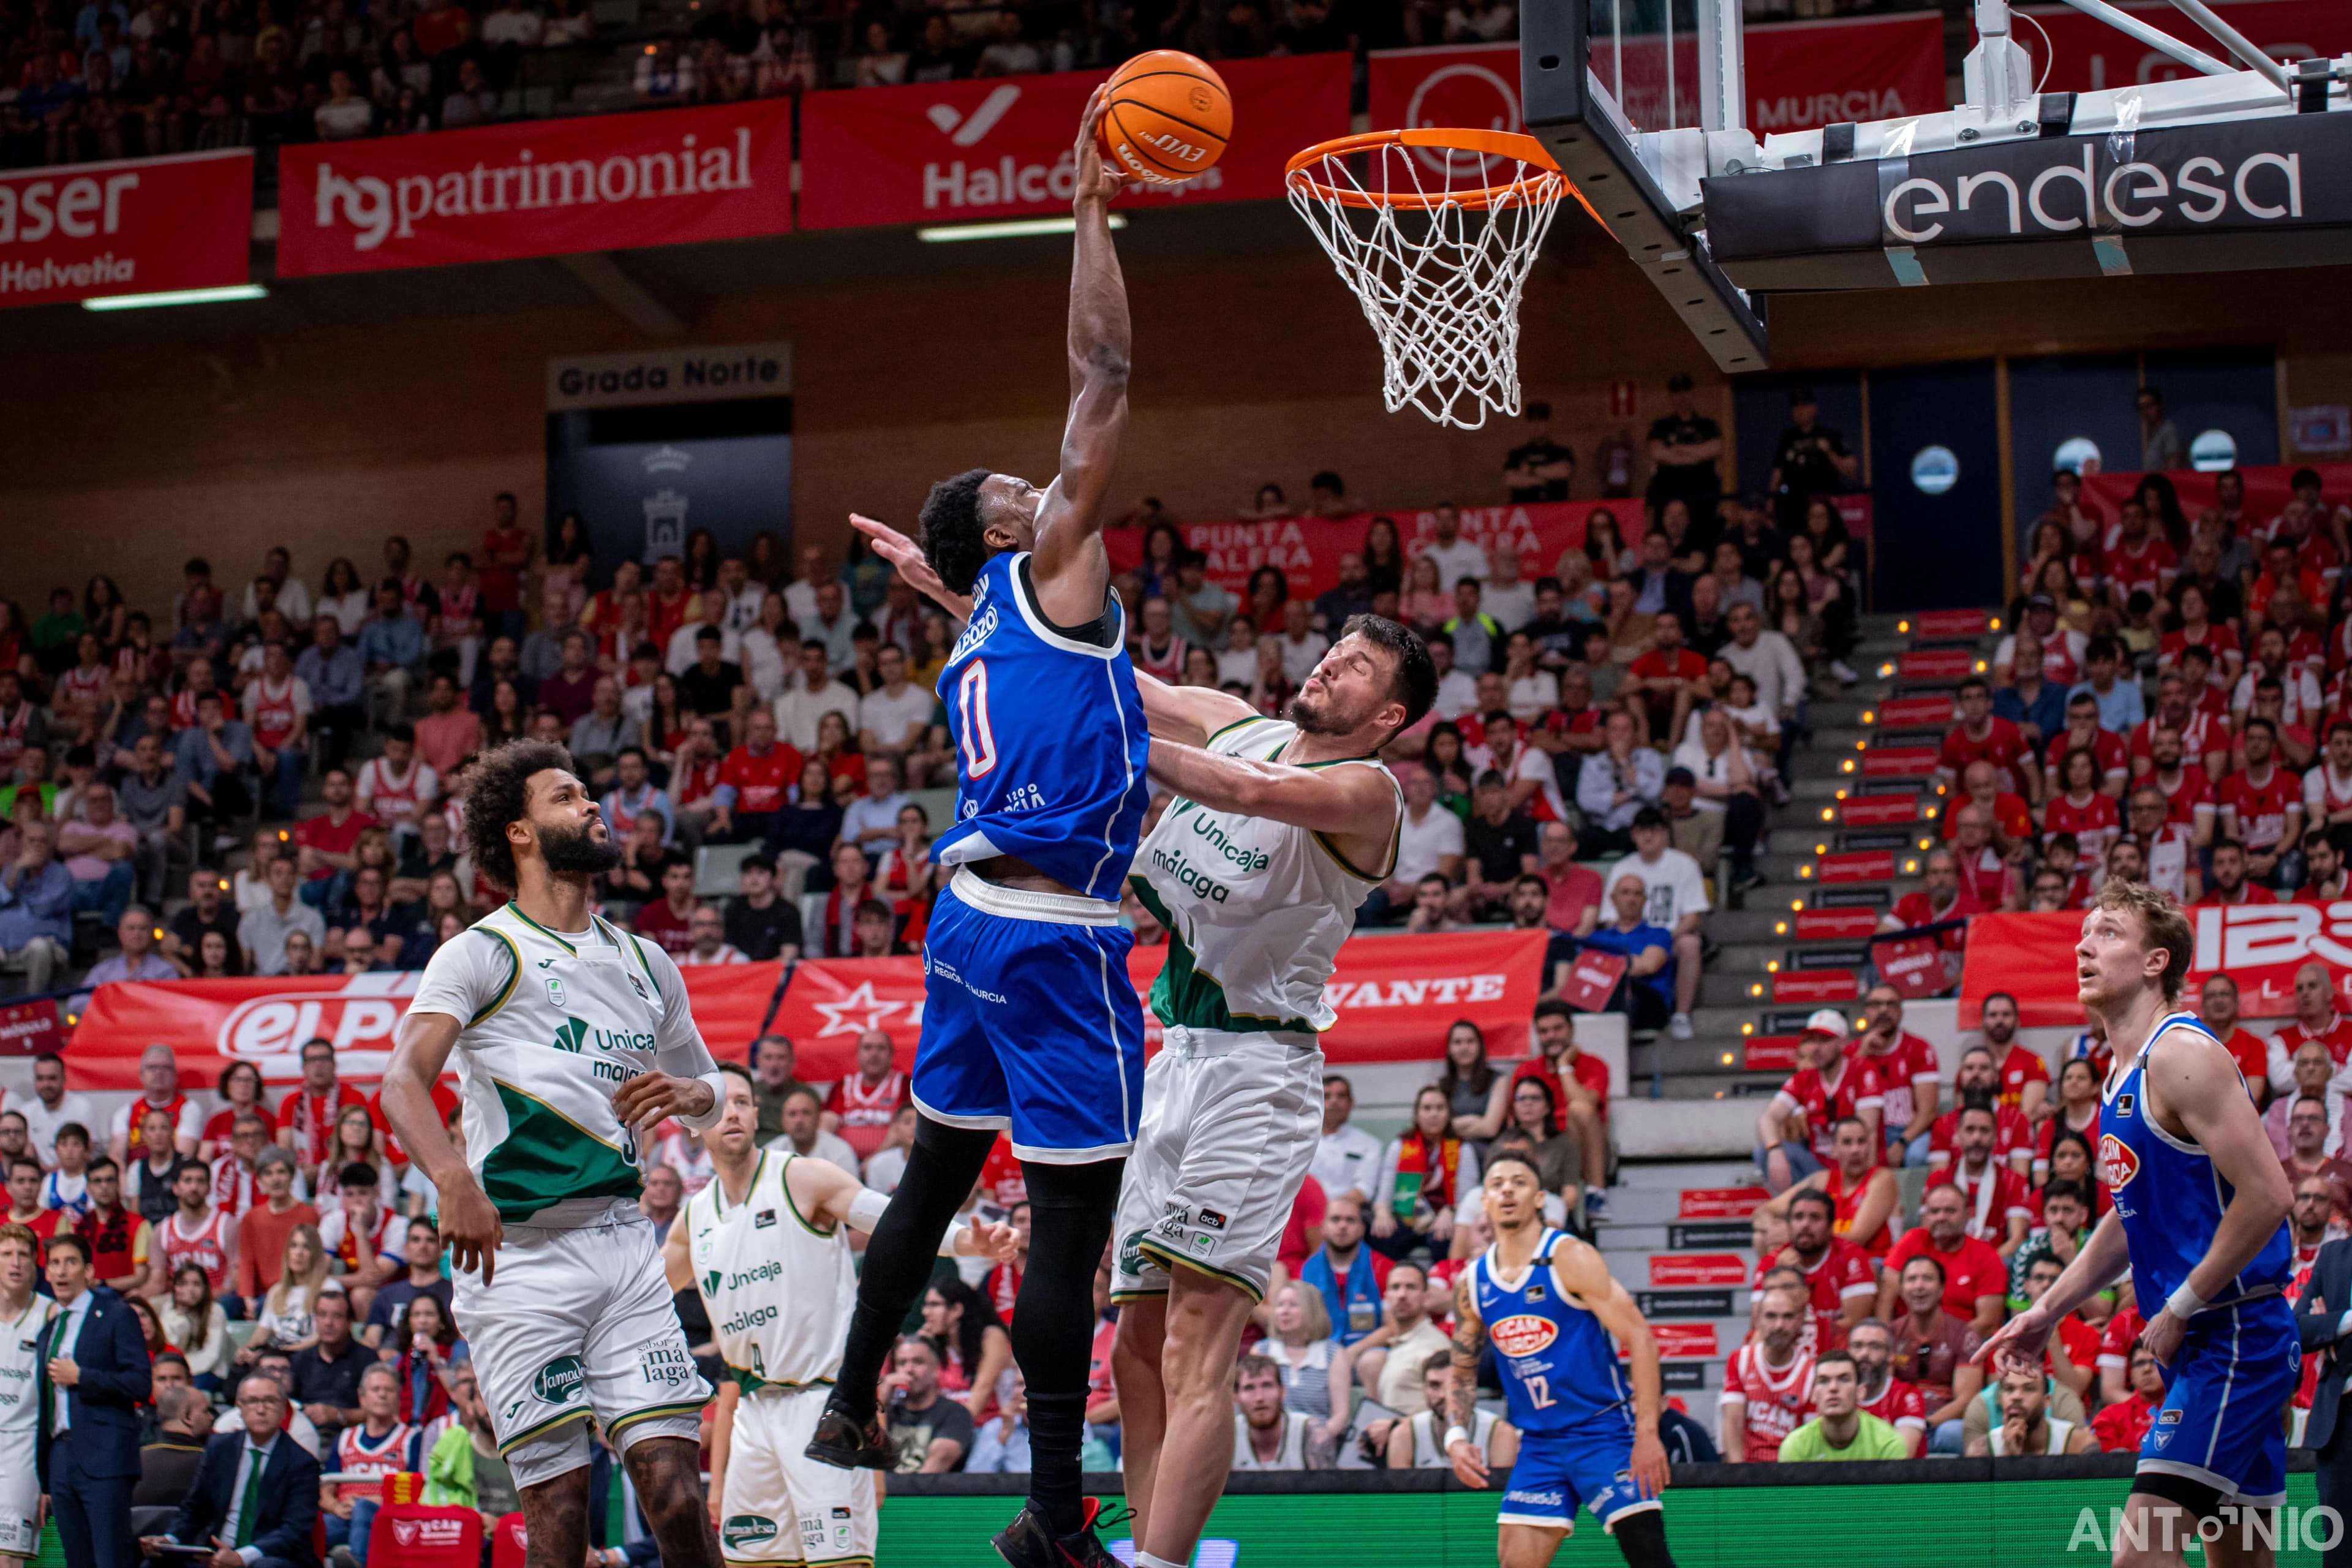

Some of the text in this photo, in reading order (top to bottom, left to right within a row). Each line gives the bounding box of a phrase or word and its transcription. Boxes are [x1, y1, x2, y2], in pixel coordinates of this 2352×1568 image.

[1756, 88, 1906, 124] MURCIA
[1154, 134, 1206, 162] EVO
[924, 149, 1118, 209] Halcó
[1884, 143, 2302, 243] endesa
[0, 251, 136, 293] Helvetia
[559, 356, 780, 396] Grada Norte
[1189, 521, 1304, 548] PUNTA
[1416, 507, 1532, 535] PNTA
[1206, 545, 1313, 571] ALERA
[958, 657, 997, 781] 0
[1193, 812, 1269, 872] Unicaja
[1323, 974, 1506, 1008] VANTE
[2101, 1139, 2121, 1161] CAM
[1200, 1215, 1219, 1226] acb
[1494, 1319, 1542, 1338] UCAM
[638, 1339, 669, 1354] sabor
[648, 1343, 687, 1365] má
[642, 1363, 690, 1386] laga
[1523, 1375, 1558, 1410] 12
